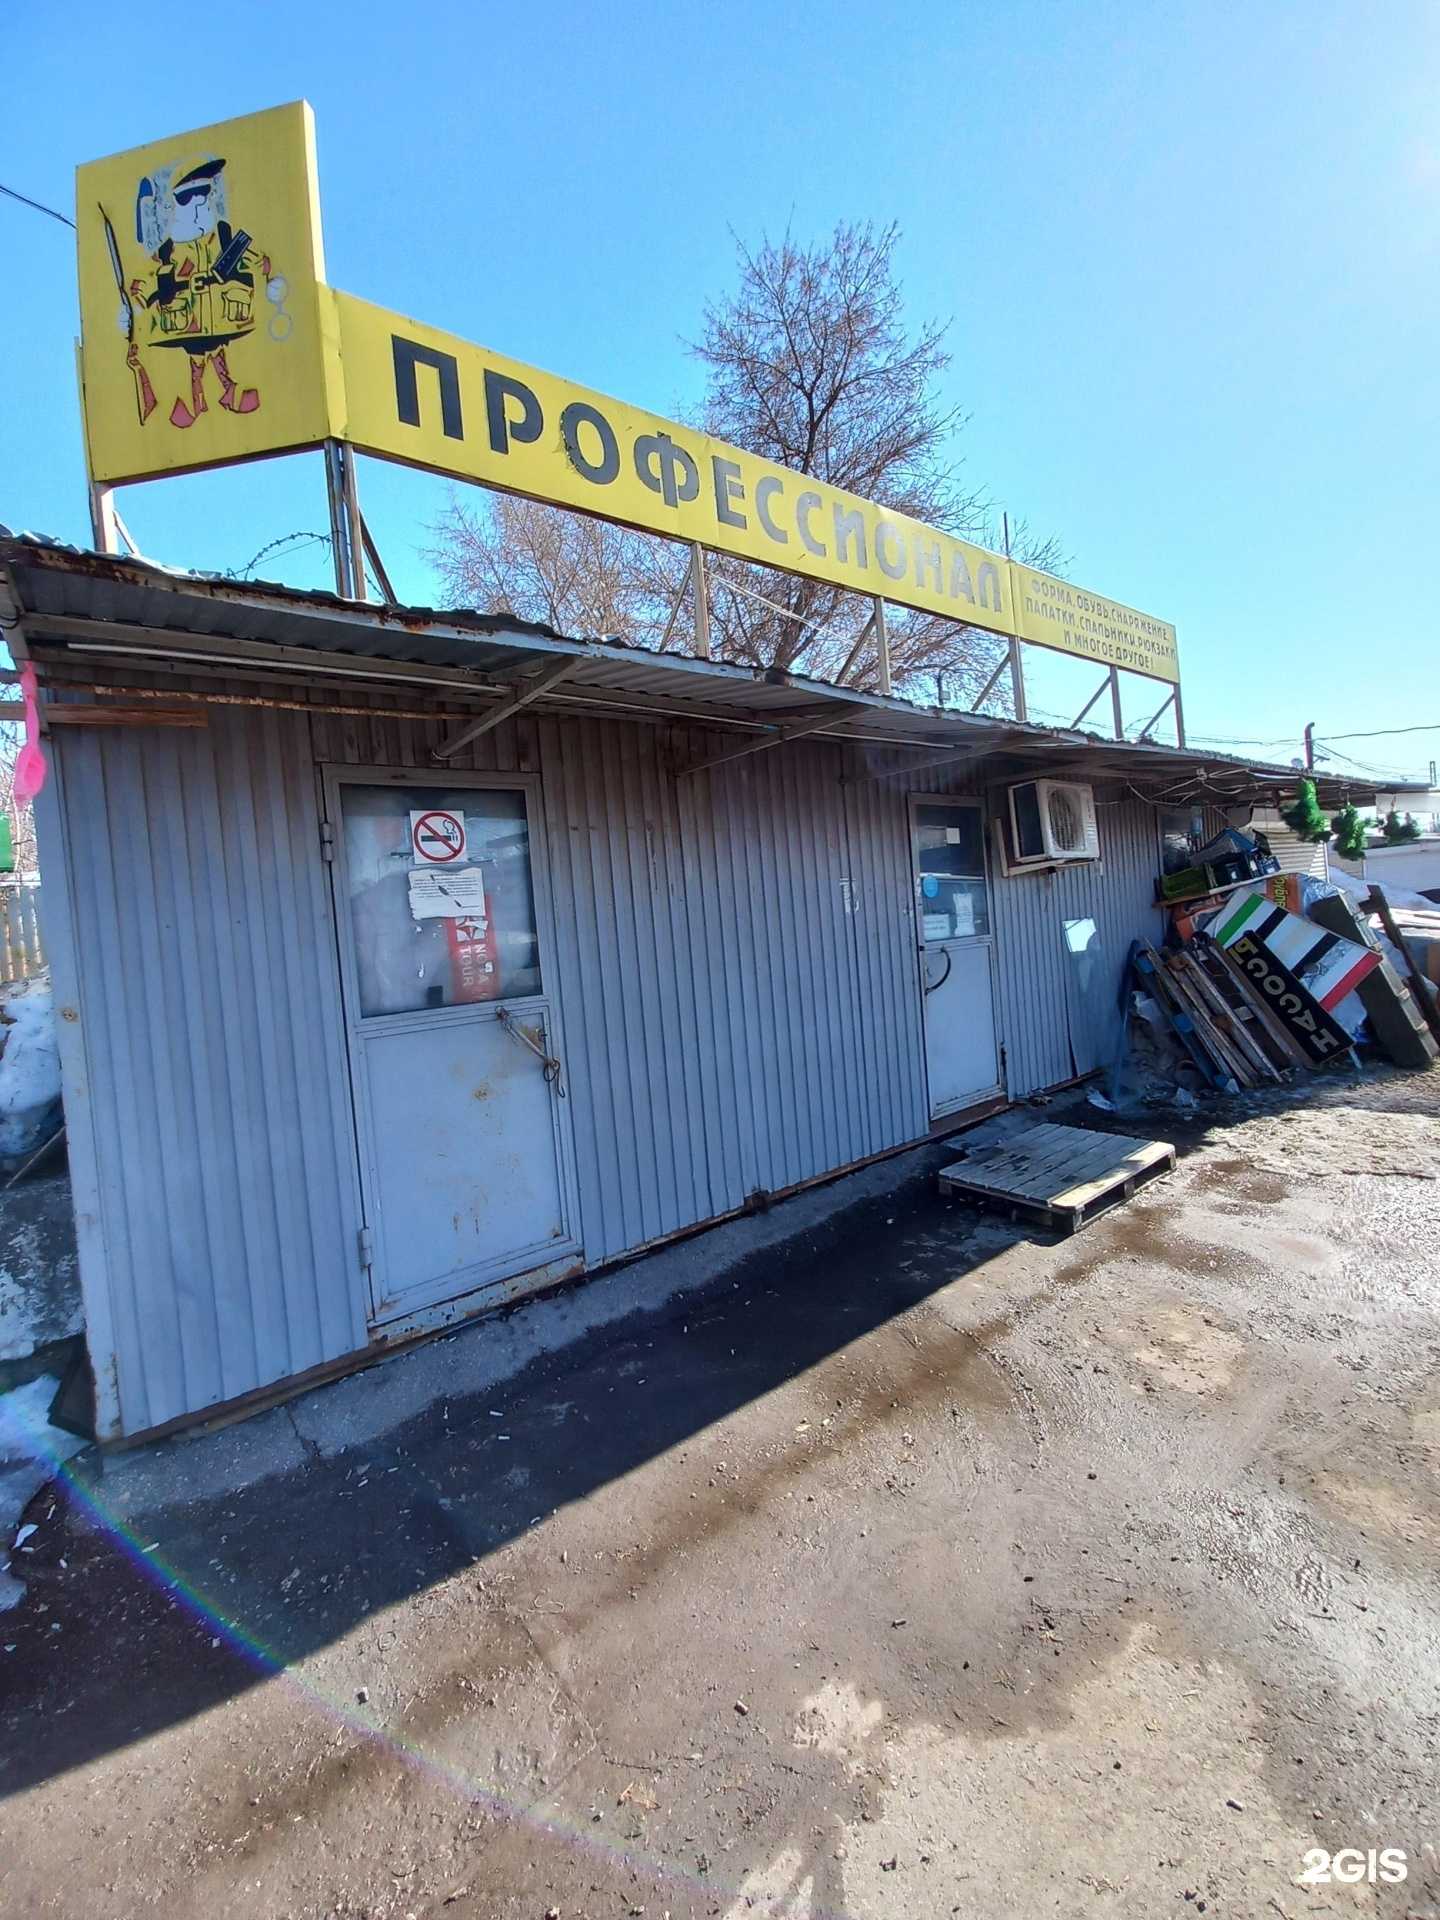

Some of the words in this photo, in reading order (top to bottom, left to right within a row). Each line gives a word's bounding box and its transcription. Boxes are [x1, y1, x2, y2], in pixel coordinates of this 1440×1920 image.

[391, 334, 1002, 613] ПРОФЕССИОНАЛ
[1063, 629, 1072, 645] И
[1074, 634, 1114, 658] МНОГОЕ
[1229, 937, 1339, 1053] НАСОСЫ
